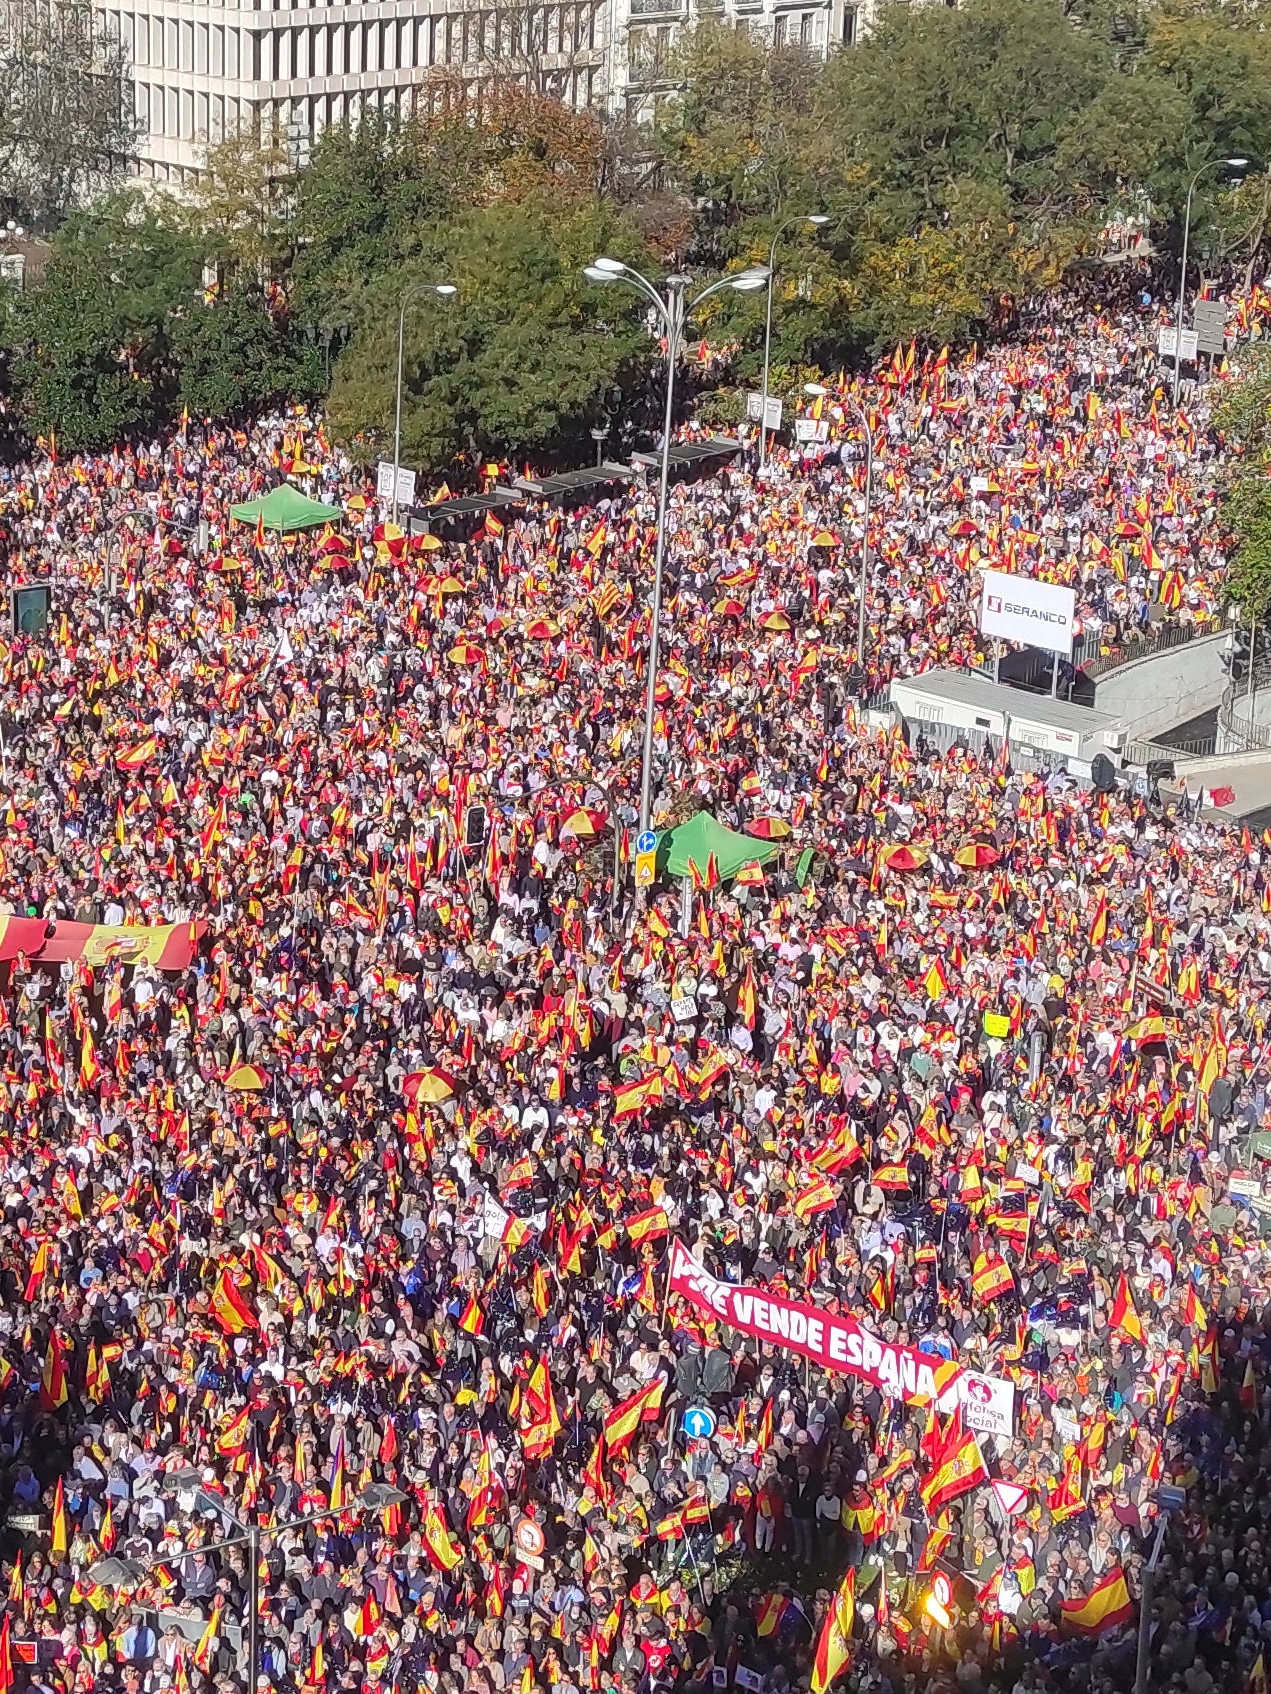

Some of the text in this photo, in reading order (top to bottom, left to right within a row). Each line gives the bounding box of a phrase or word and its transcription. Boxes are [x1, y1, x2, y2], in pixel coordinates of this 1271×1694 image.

[1004, 602, 1066, 625] SERANCO
[732, 1291, 824, 1355] VENDE
[829, 1325, 939, 1400] ESPAÑA
